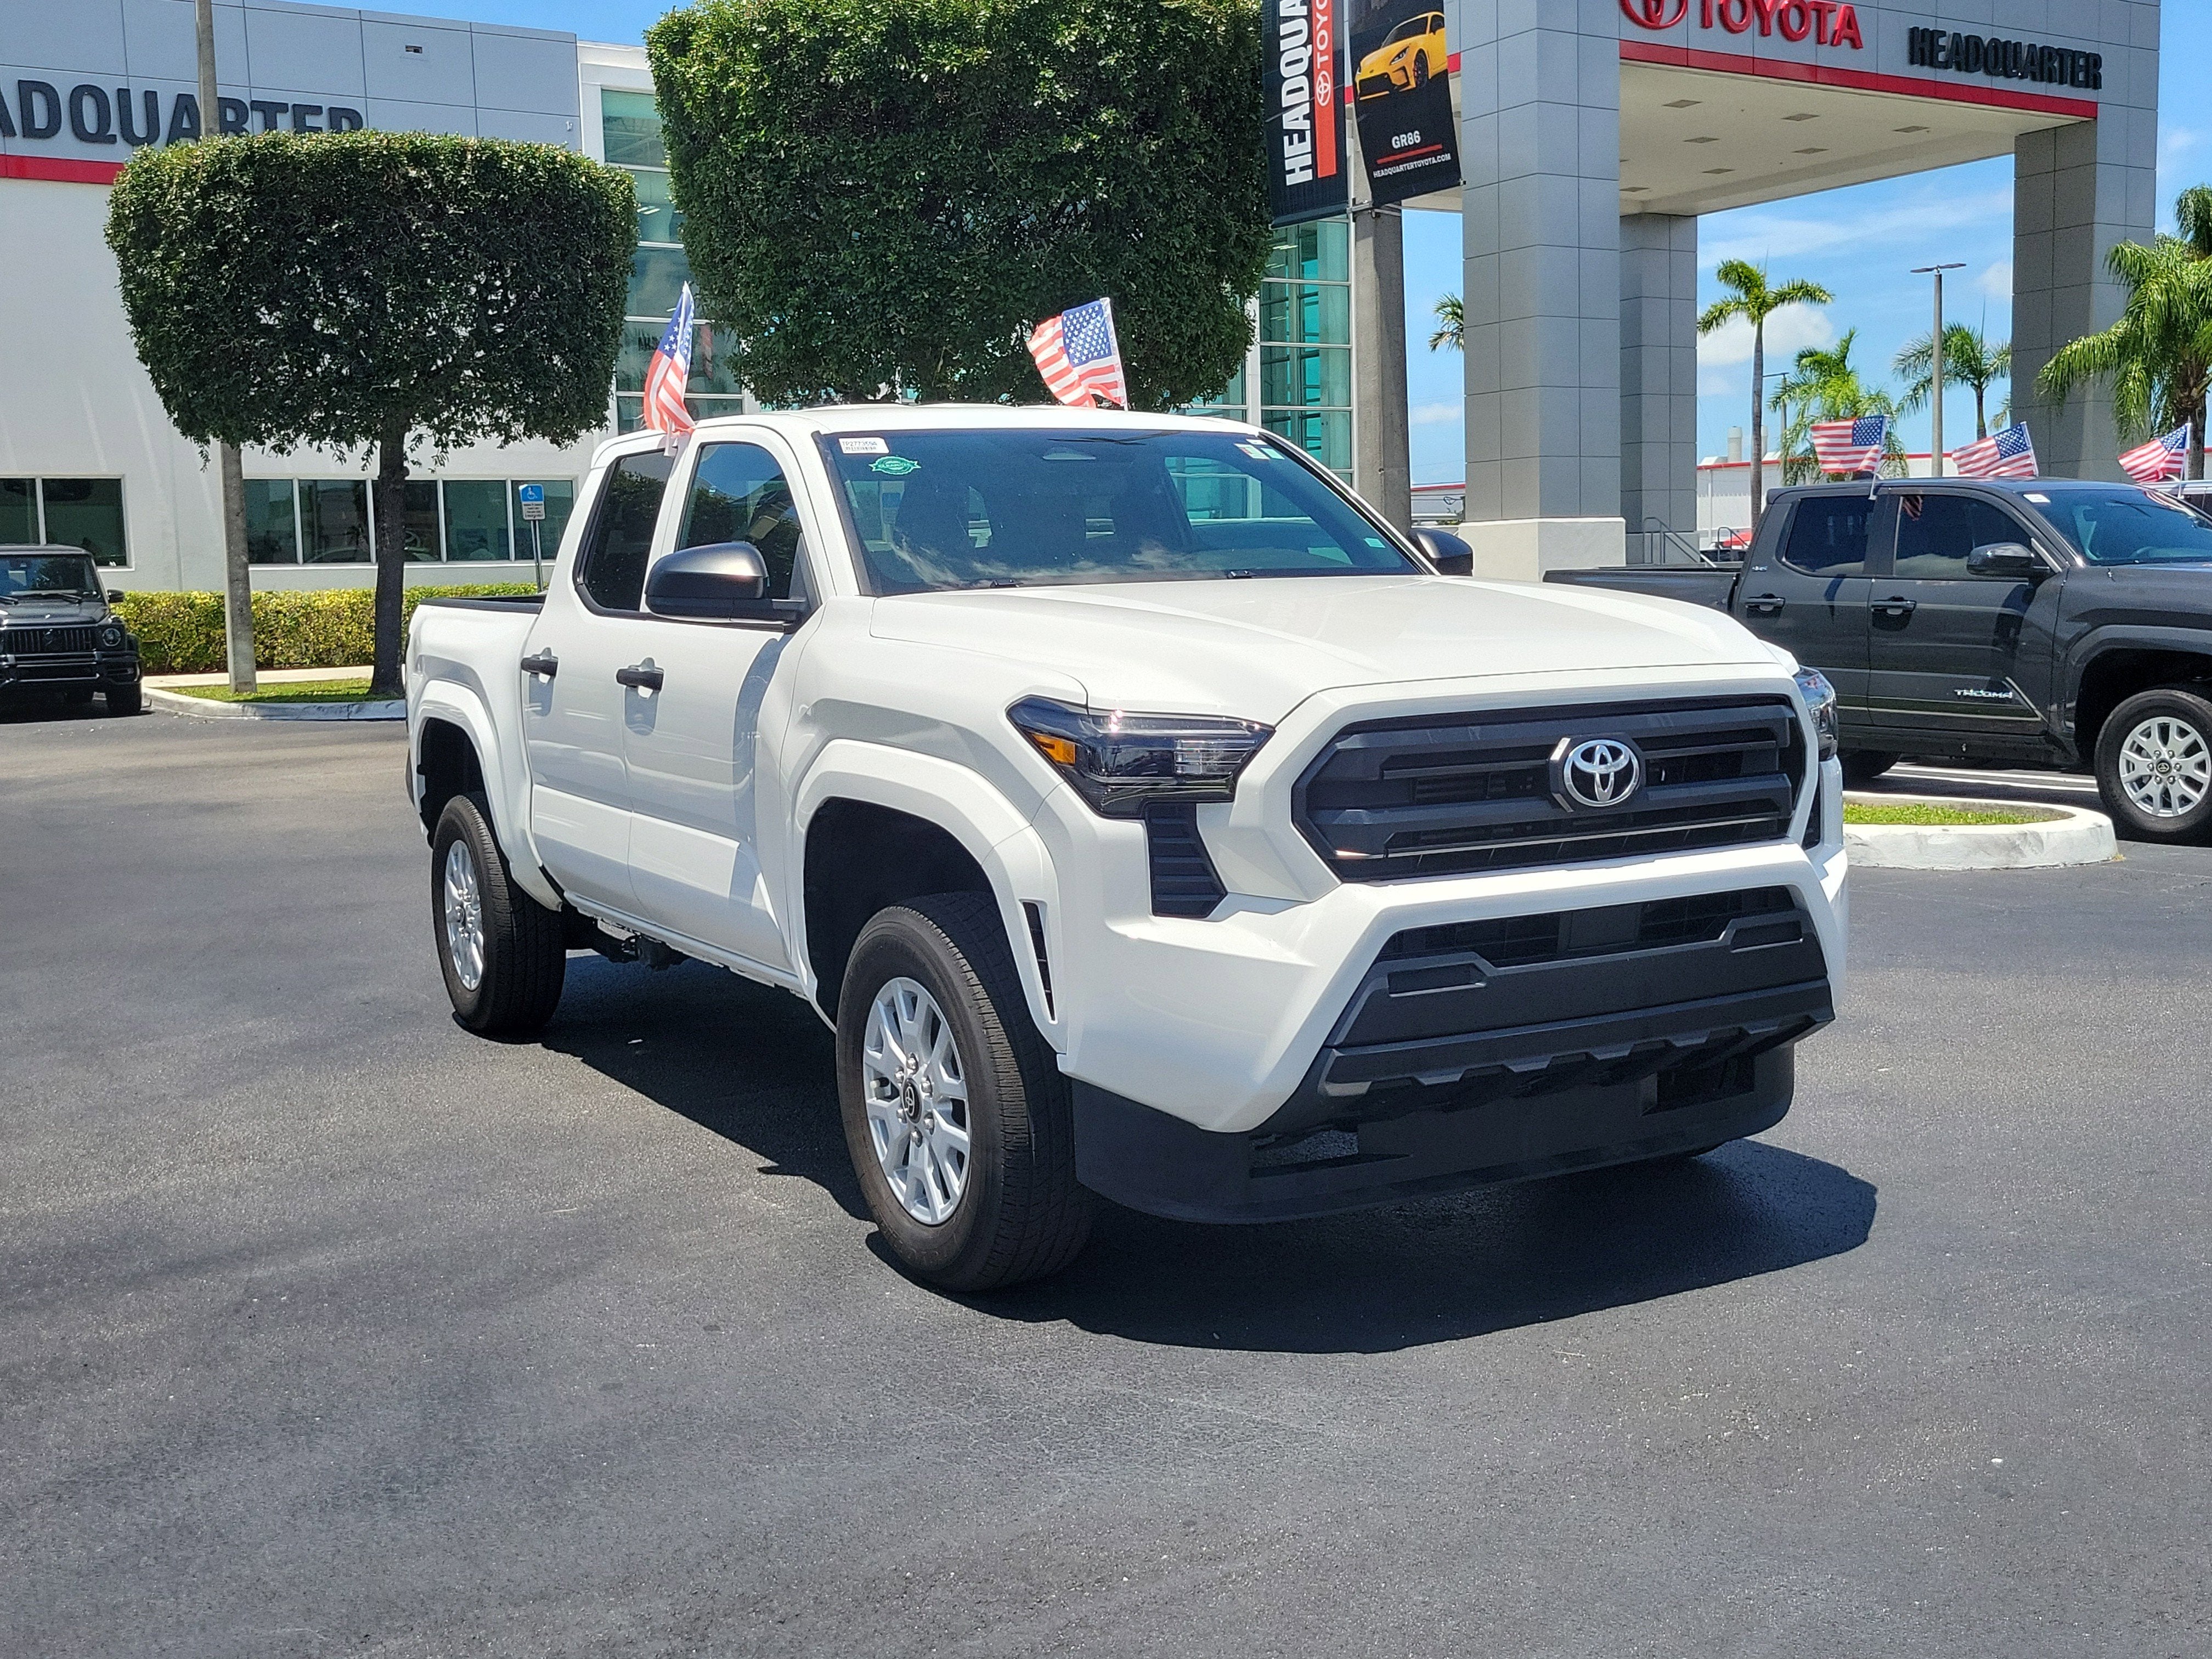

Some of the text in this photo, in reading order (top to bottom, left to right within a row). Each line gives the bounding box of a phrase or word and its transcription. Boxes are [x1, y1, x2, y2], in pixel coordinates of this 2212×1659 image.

[1700, 0, 1864, 50] TOYOTA
[1909, 26, 2102, 89] HEADQUARTER
[1279, 0, 1312, 185] HEADQUA
[1391, 130, 1421, 149] GR86
[1373, 153, 1452, 178] HEADQUARTERTOYOTA.COM
